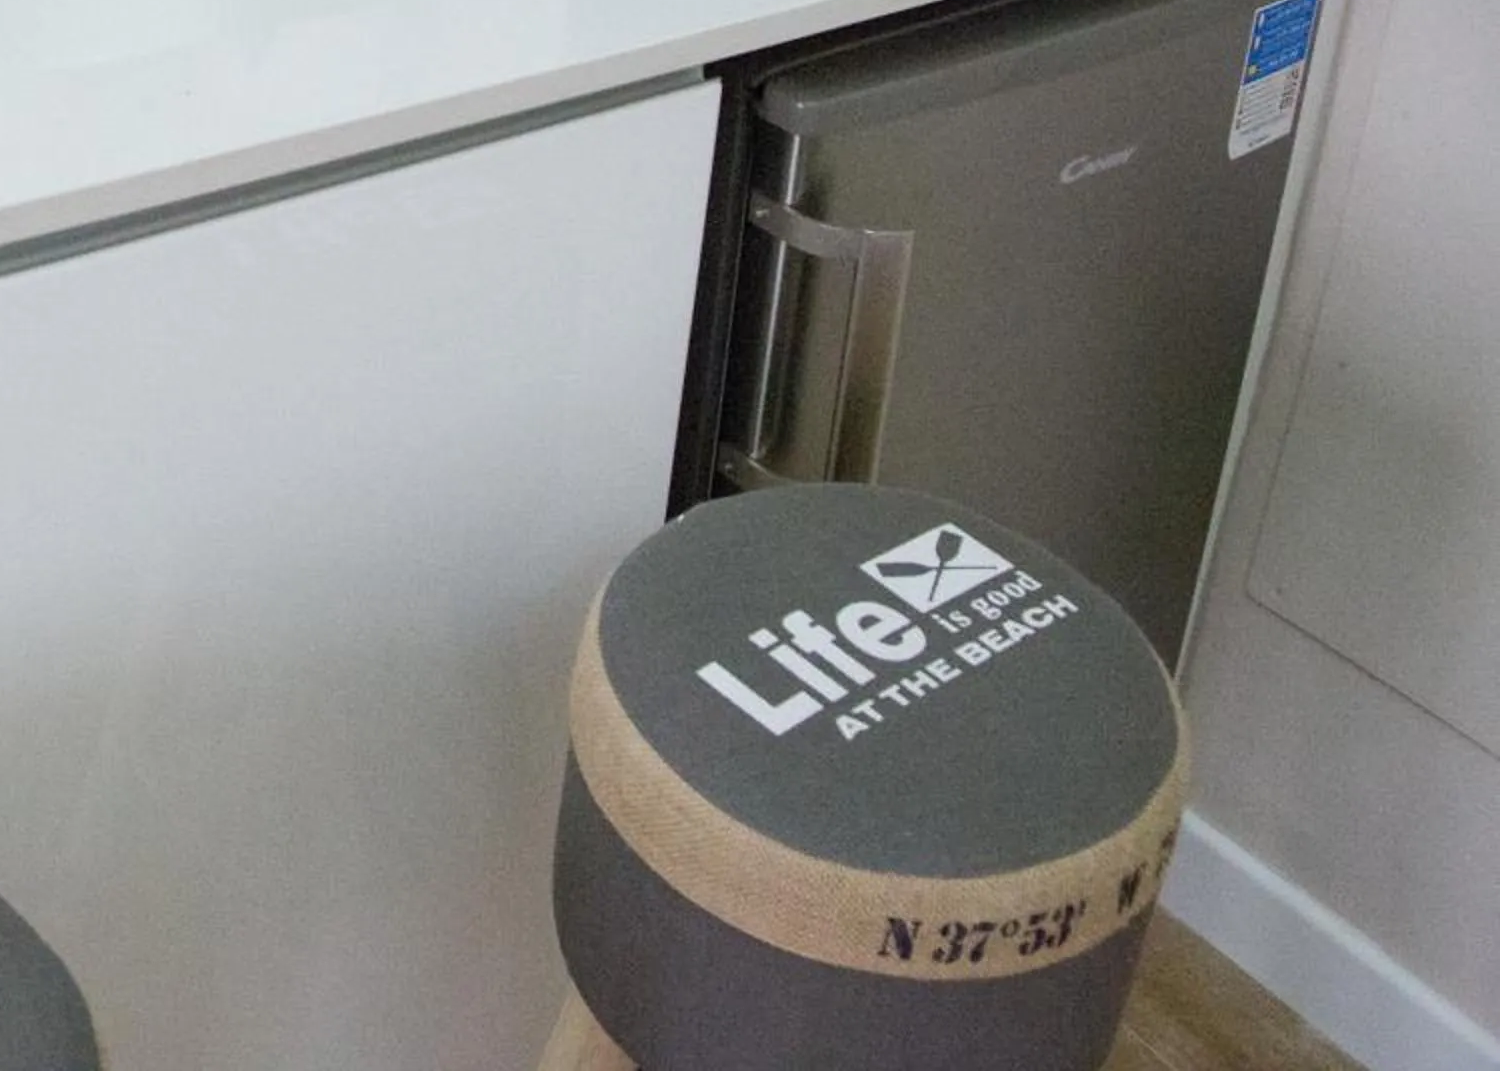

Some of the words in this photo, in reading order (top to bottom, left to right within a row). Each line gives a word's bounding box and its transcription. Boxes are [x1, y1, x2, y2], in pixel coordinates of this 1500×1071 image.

[930, 609, 973, 634] is
[969, 570, 1044, 621] good
[696, 600, 928, 736] Life
[835, 698, 885, 741] AT
[879, 657, 964, 707] THE
[954, 593, 1080, 667] BEACH
[876, 916, 923, 961] N
